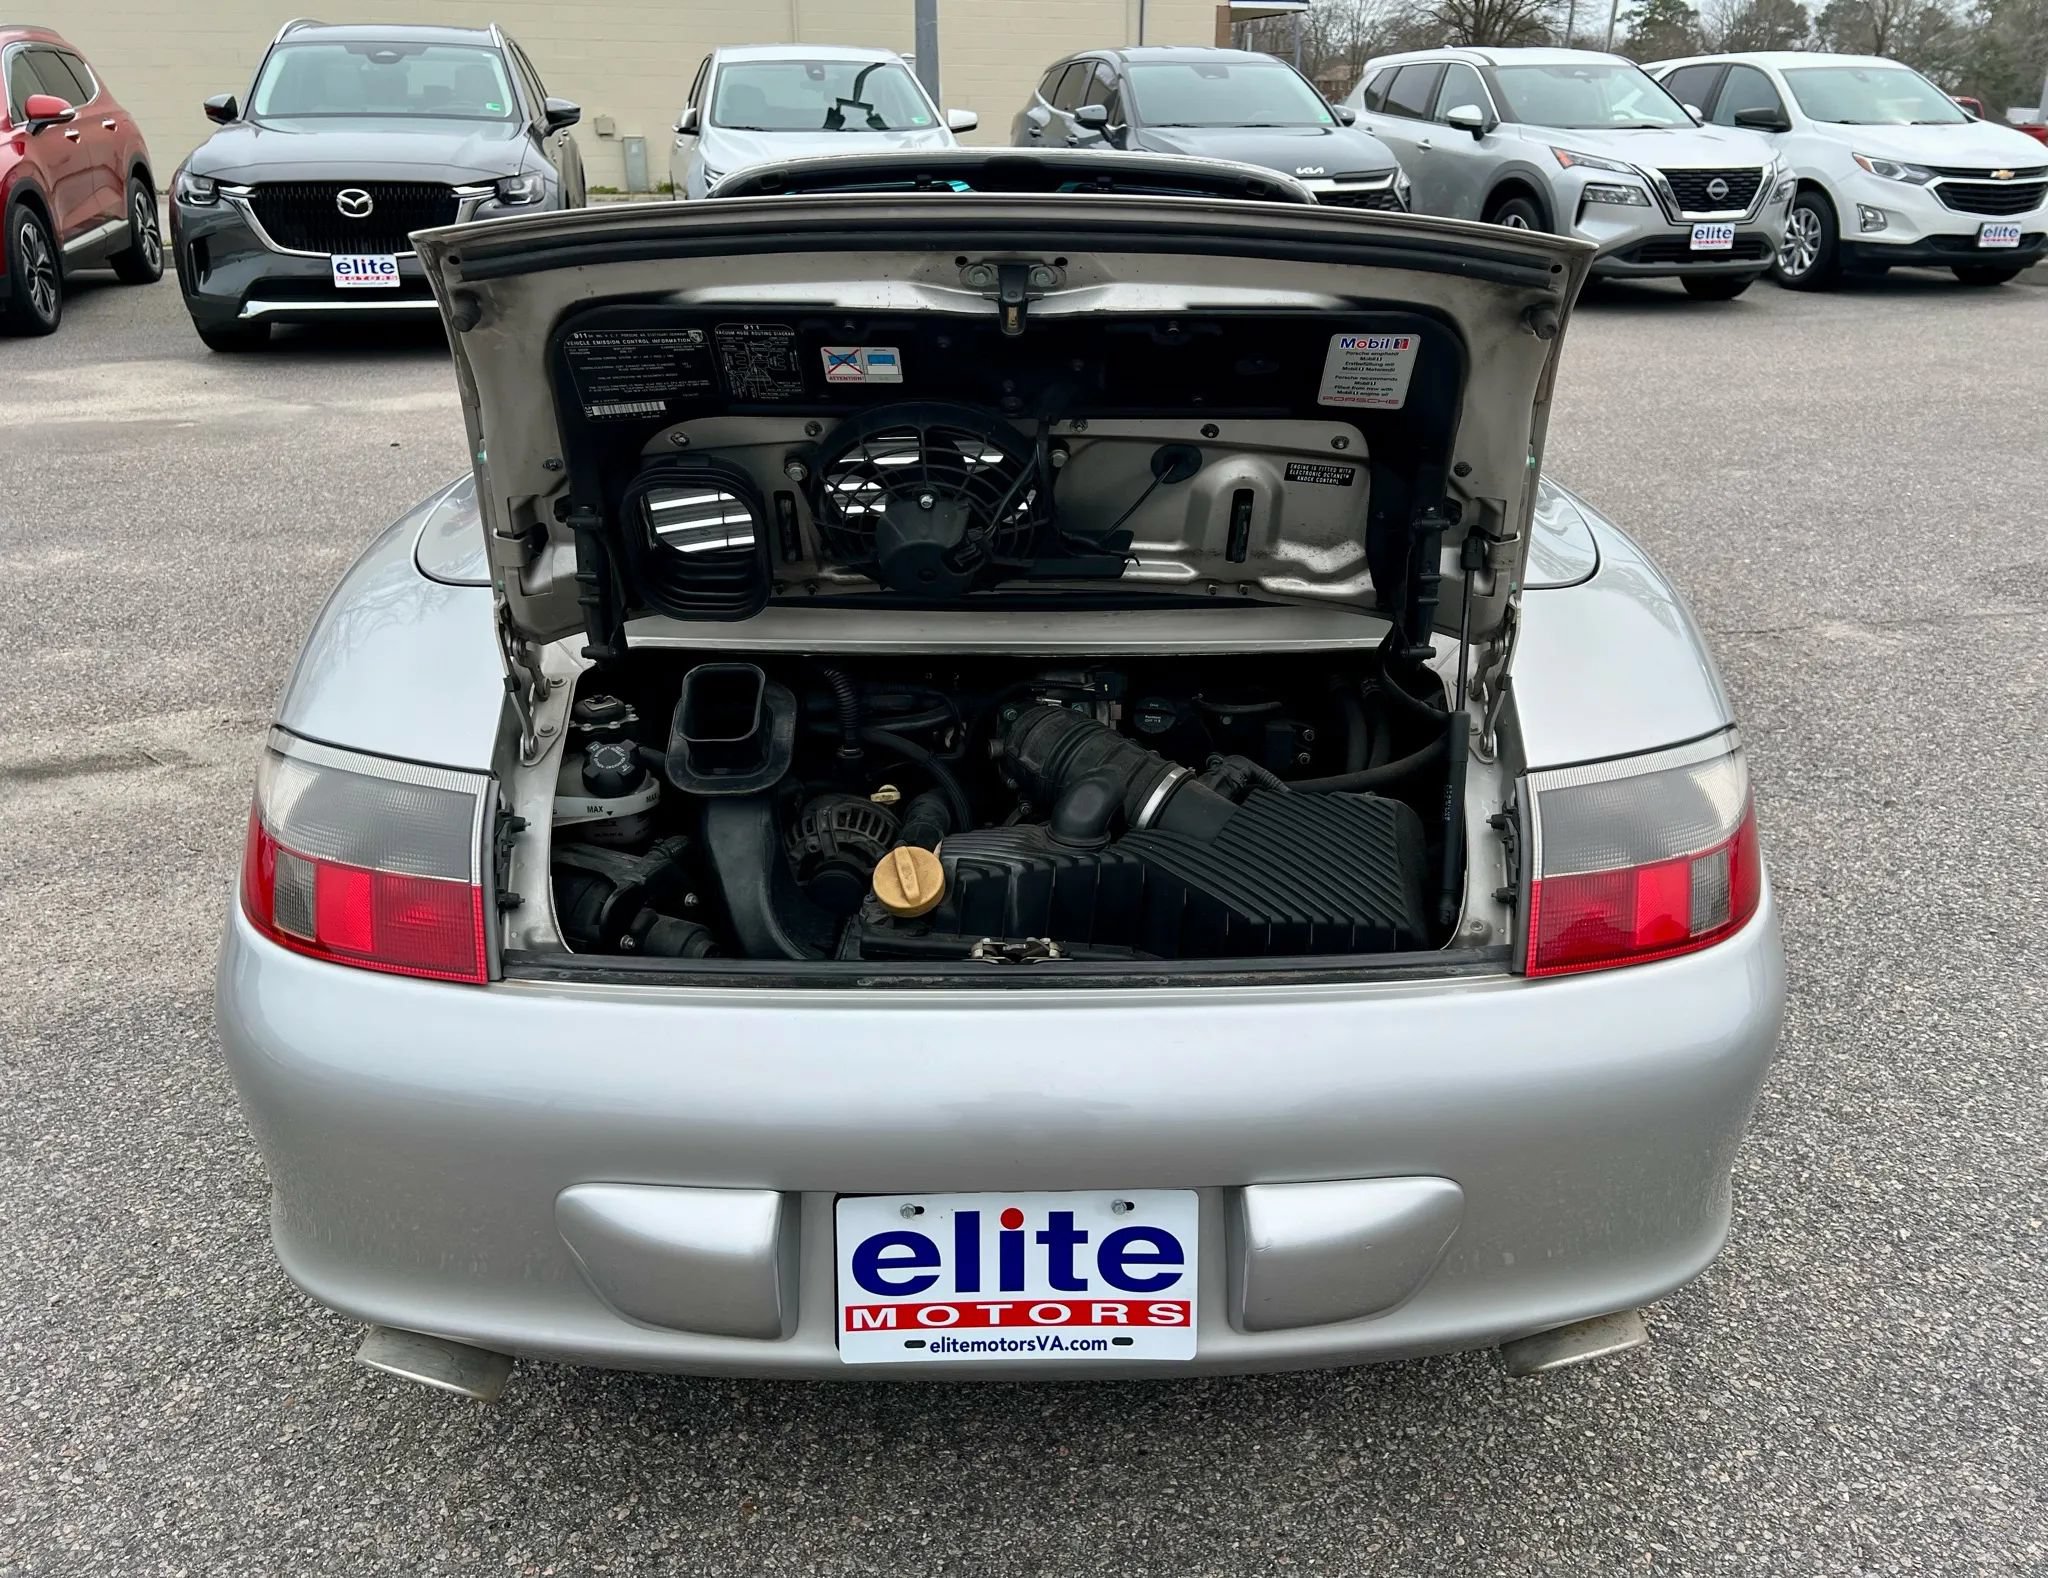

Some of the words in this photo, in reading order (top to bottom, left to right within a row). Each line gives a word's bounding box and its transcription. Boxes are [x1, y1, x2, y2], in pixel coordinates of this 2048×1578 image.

[1694, 226, 1732, 239] elite
[1983, 226, 2019, 238] elite
[336, 258, 395, 274] elite
[1340, 338, 1390, 349] Mobil
[1322, 396, 1399, 404] PORSCHE
[1290, 463, 1310, 471] ENGINE
[1289, 469, 1322, 477] ELECTRONIC
[1316, 477, 1339, 485] CONTROL
[587, 805, 603, 813] MAX
[852, 1207, 1185, 1296] elite
[852, 1303, 1185, 1328] MOTORS
[930, 1335, 1108, 1353] elitemotorsVA.com
